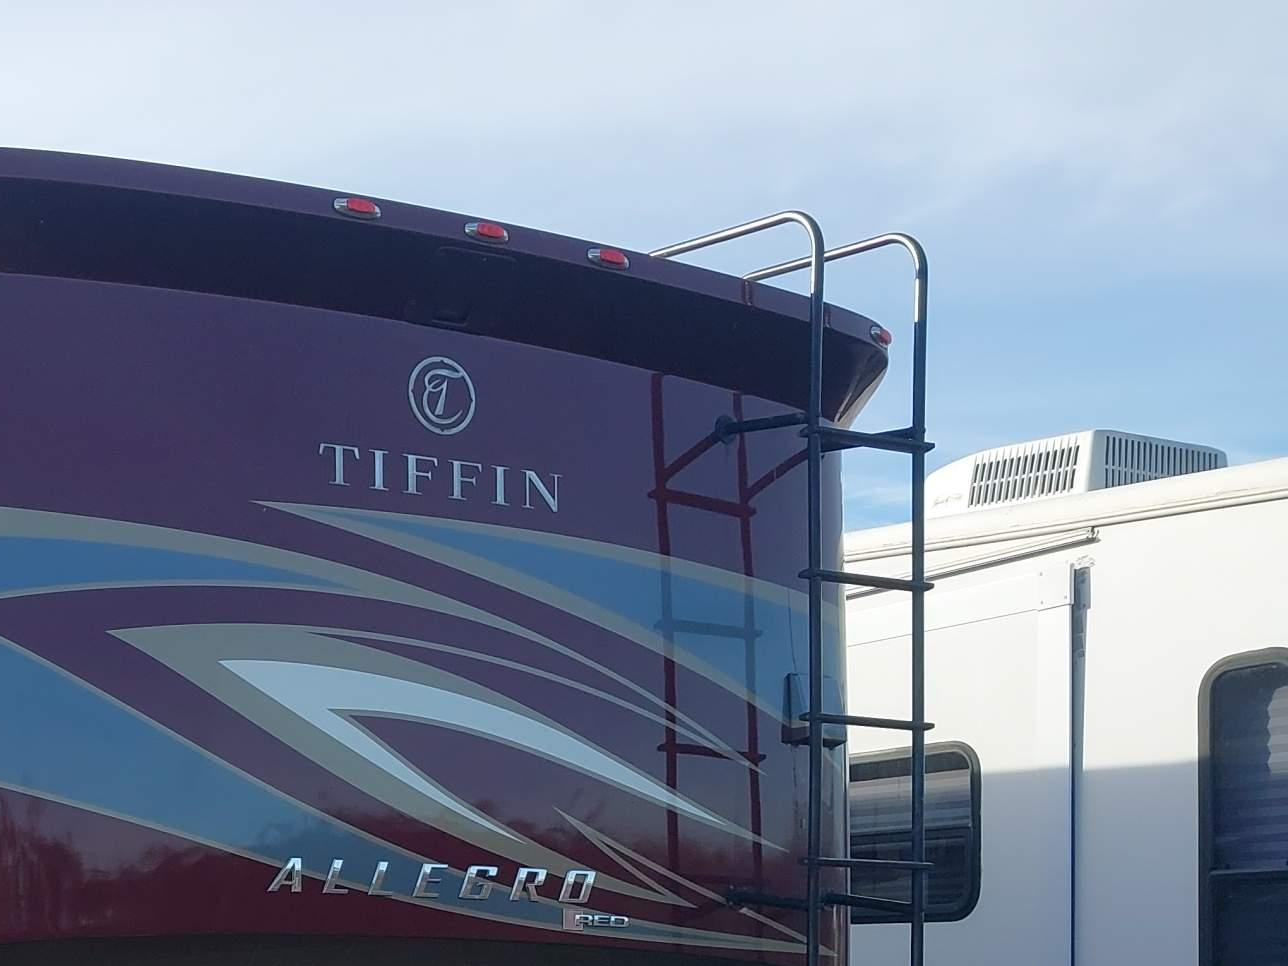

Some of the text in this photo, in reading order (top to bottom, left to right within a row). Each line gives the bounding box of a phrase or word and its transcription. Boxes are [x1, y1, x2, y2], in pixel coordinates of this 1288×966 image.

[318, 442, 563, 513] TIFFIN
[266, 857, 598, 904] ALLEGRO
[574, 914, 630, 928] RED
